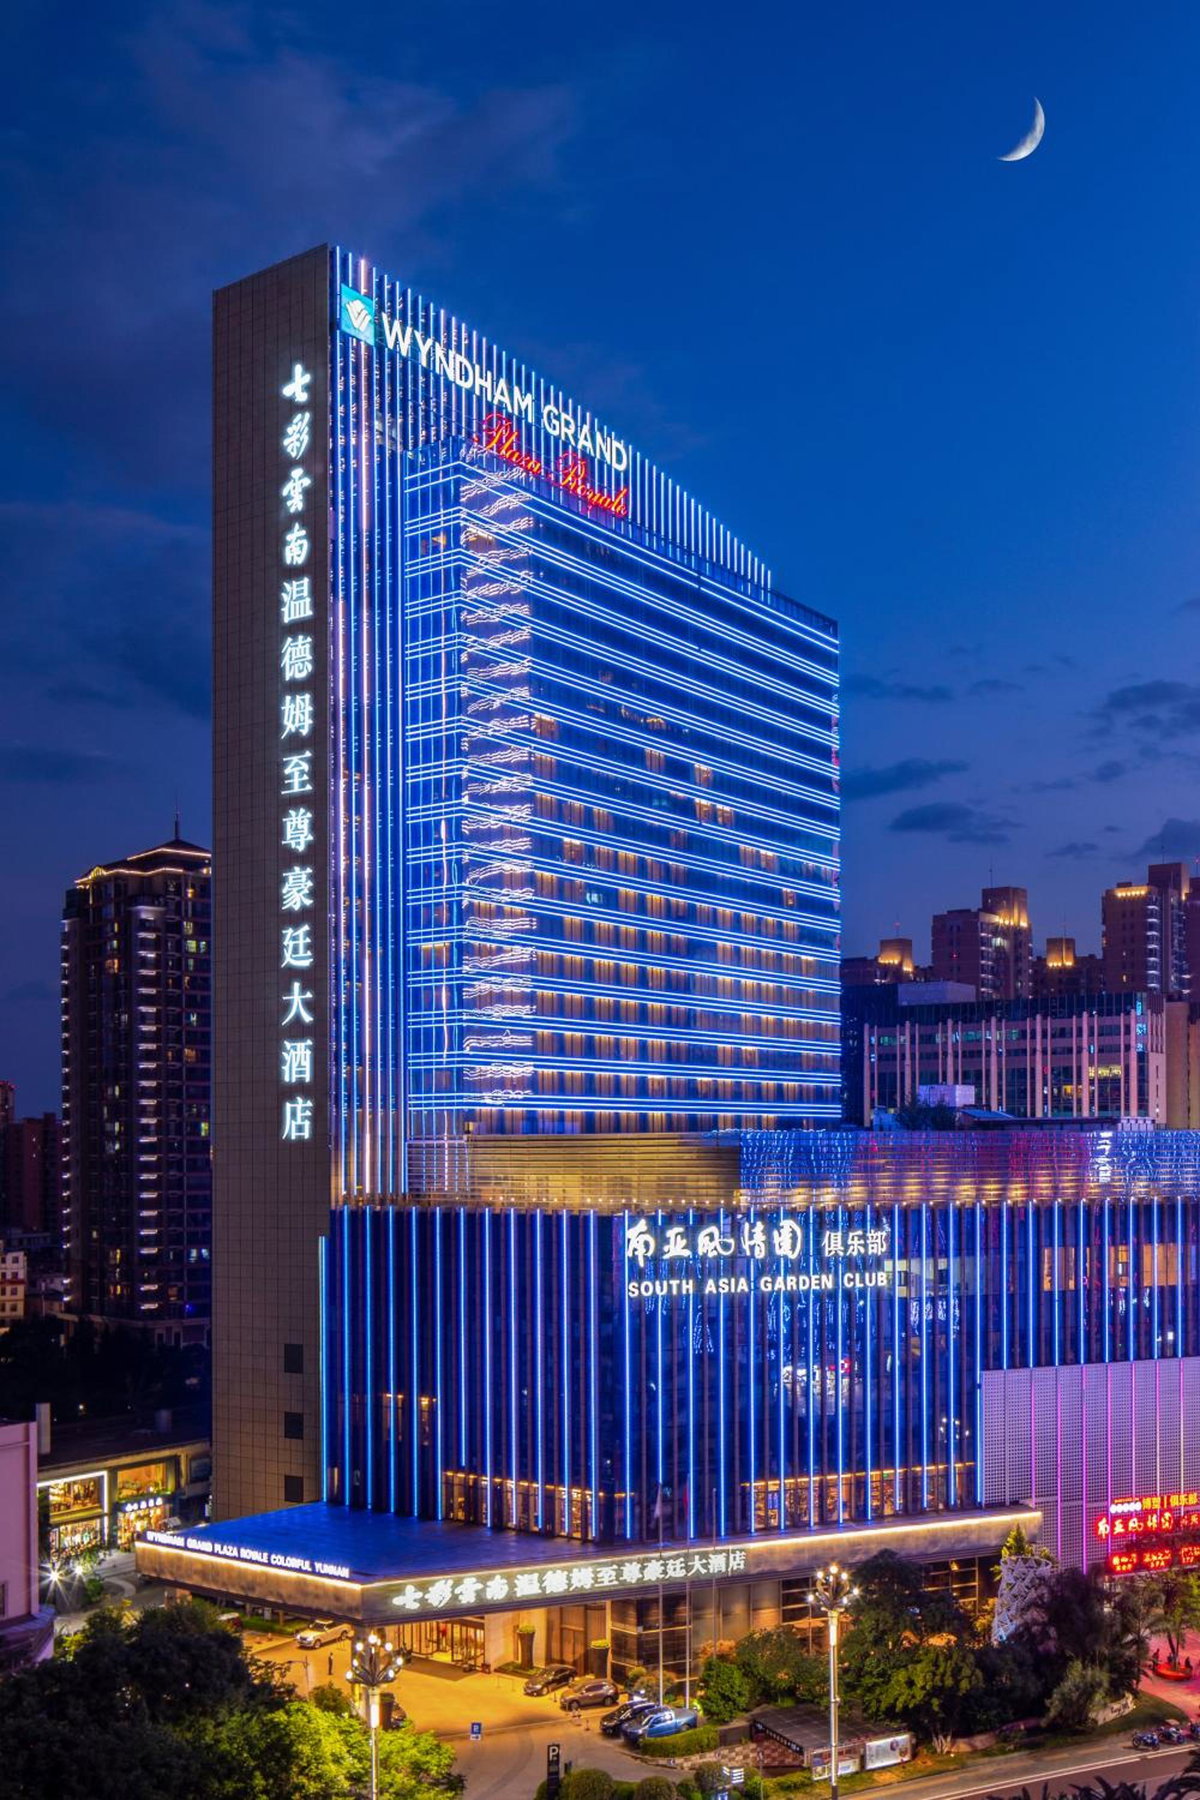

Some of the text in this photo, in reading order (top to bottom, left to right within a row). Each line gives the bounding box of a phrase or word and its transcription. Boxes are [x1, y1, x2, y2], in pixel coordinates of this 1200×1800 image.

[382, 312, 628, 471] WYNDHAM GRAND
[476, 413, 628, 518] Plaza Royale
[822, 1229, 887, 1257] 俱乐部
[628, 1271, 887, 1297] SOUTH ASIA GARDEN CLUB
[214, 1543, 239, 1557] PLAZA
[240, 1548, 268, 1563] ROYALE
[270, 1554, 312, 1571] COLORFUL
[549, 1746, 558, 1761] P
